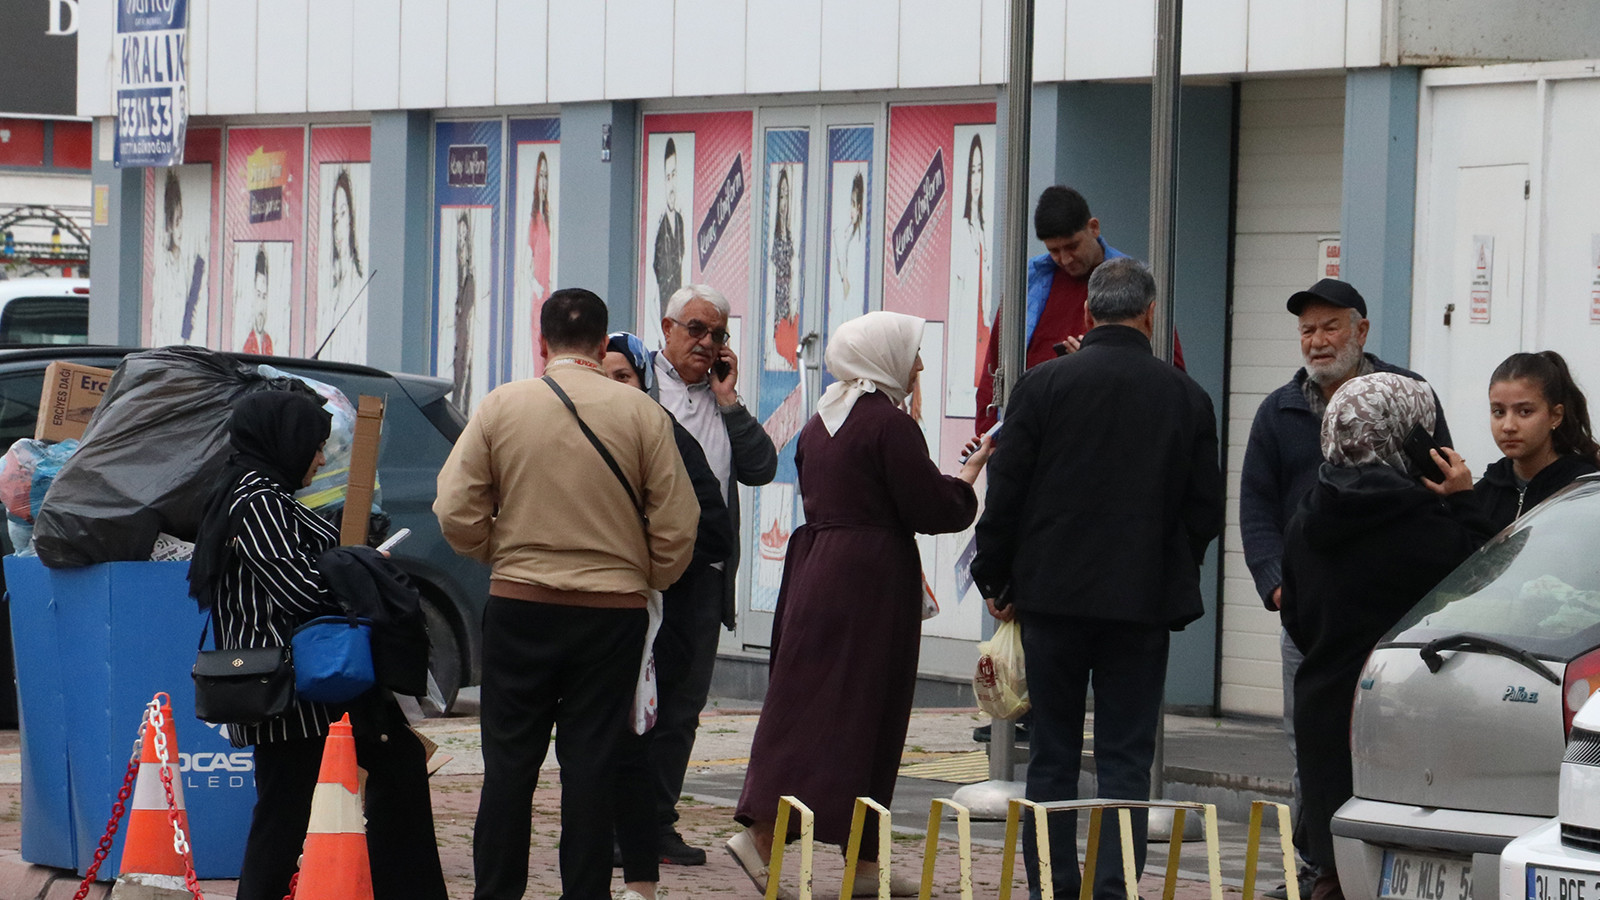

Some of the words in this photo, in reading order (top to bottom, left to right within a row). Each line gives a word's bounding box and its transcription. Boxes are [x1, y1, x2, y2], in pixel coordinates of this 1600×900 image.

[177, 752, 256, 772] OCAS
[1391, 858, 1411, 896] 06
[1416, 860, 1447, 900] MLG
